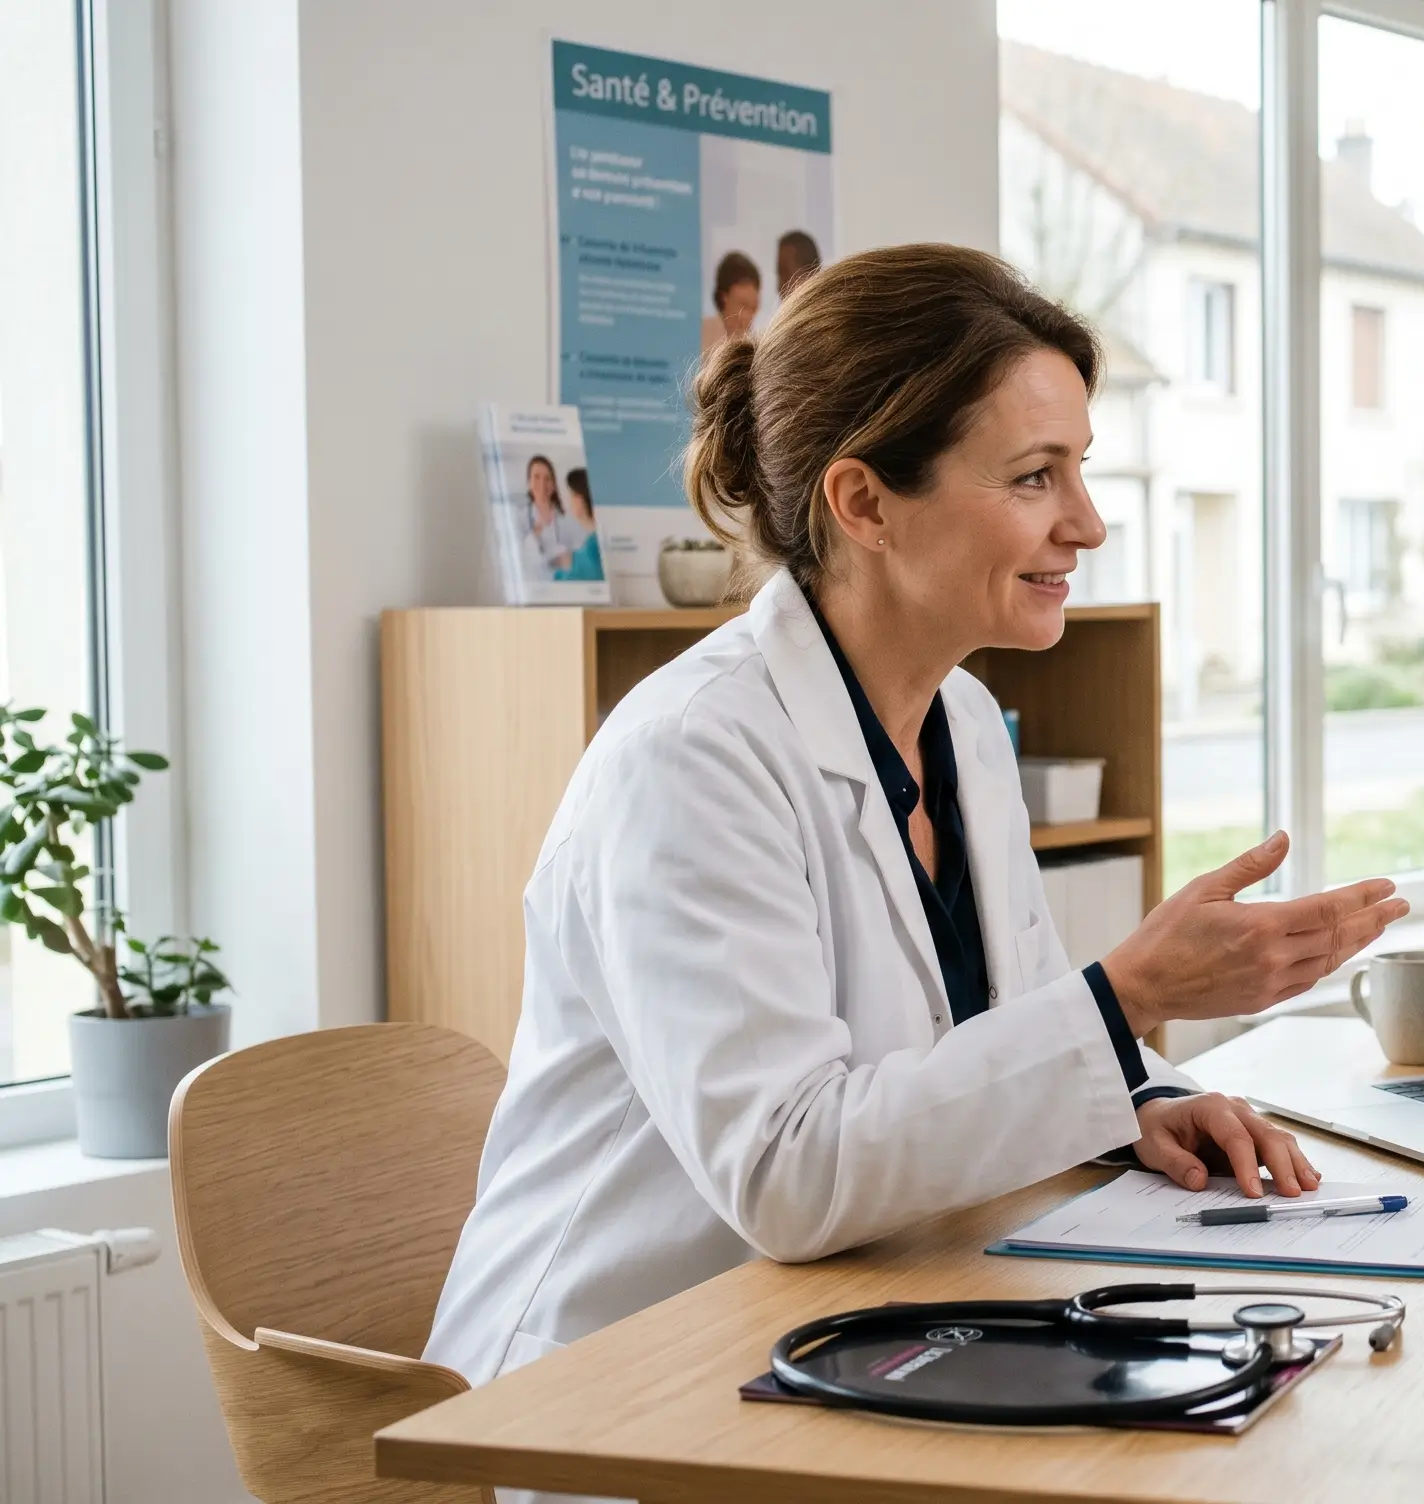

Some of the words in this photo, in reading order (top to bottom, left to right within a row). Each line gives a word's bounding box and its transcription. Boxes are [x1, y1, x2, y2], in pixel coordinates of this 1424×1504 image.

[571, 62, 650, 107] Santé
[656, 78, 677, 112] &
[683, 83, 817, 136] Prévention
